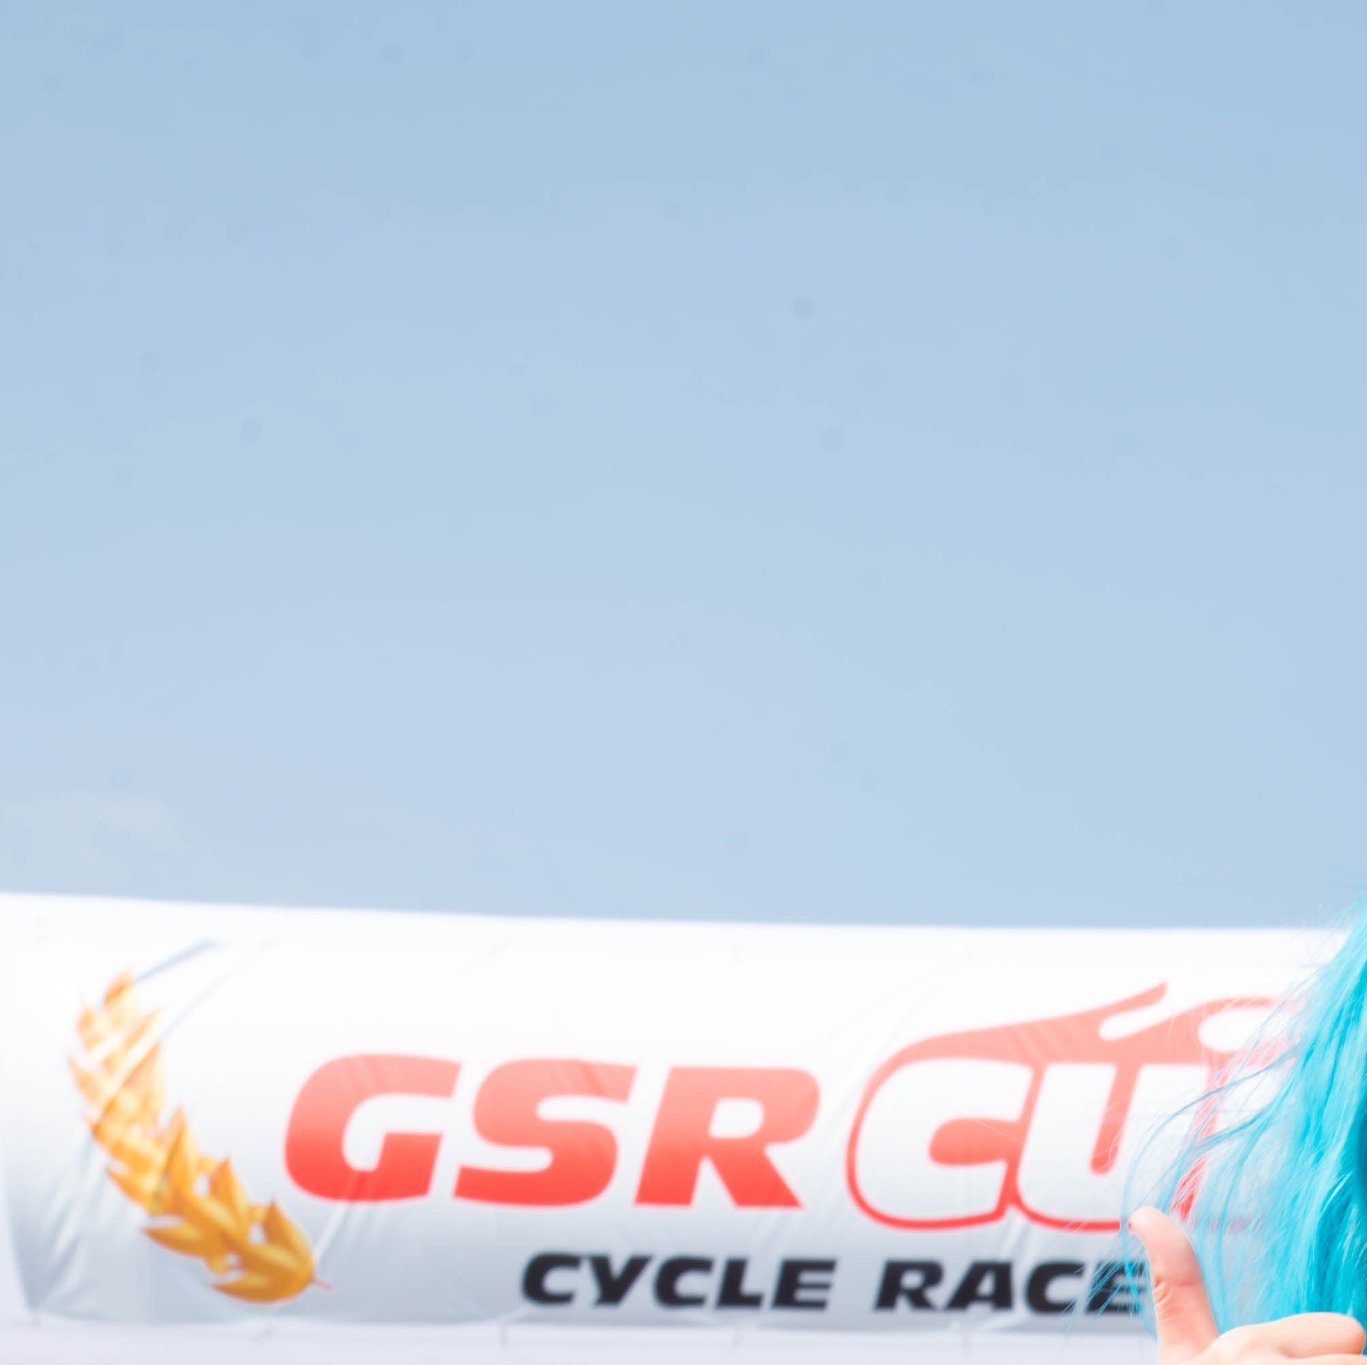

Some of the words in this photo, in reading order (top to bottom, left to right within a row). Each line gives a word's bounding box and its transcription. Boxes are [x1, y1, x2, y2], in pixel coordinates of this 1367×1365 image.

[283, 1052, 822, 1208] GSR
[521, 1251, 838, 1311] CYCLE
[873, 1258, 1150, 1316] RACE
